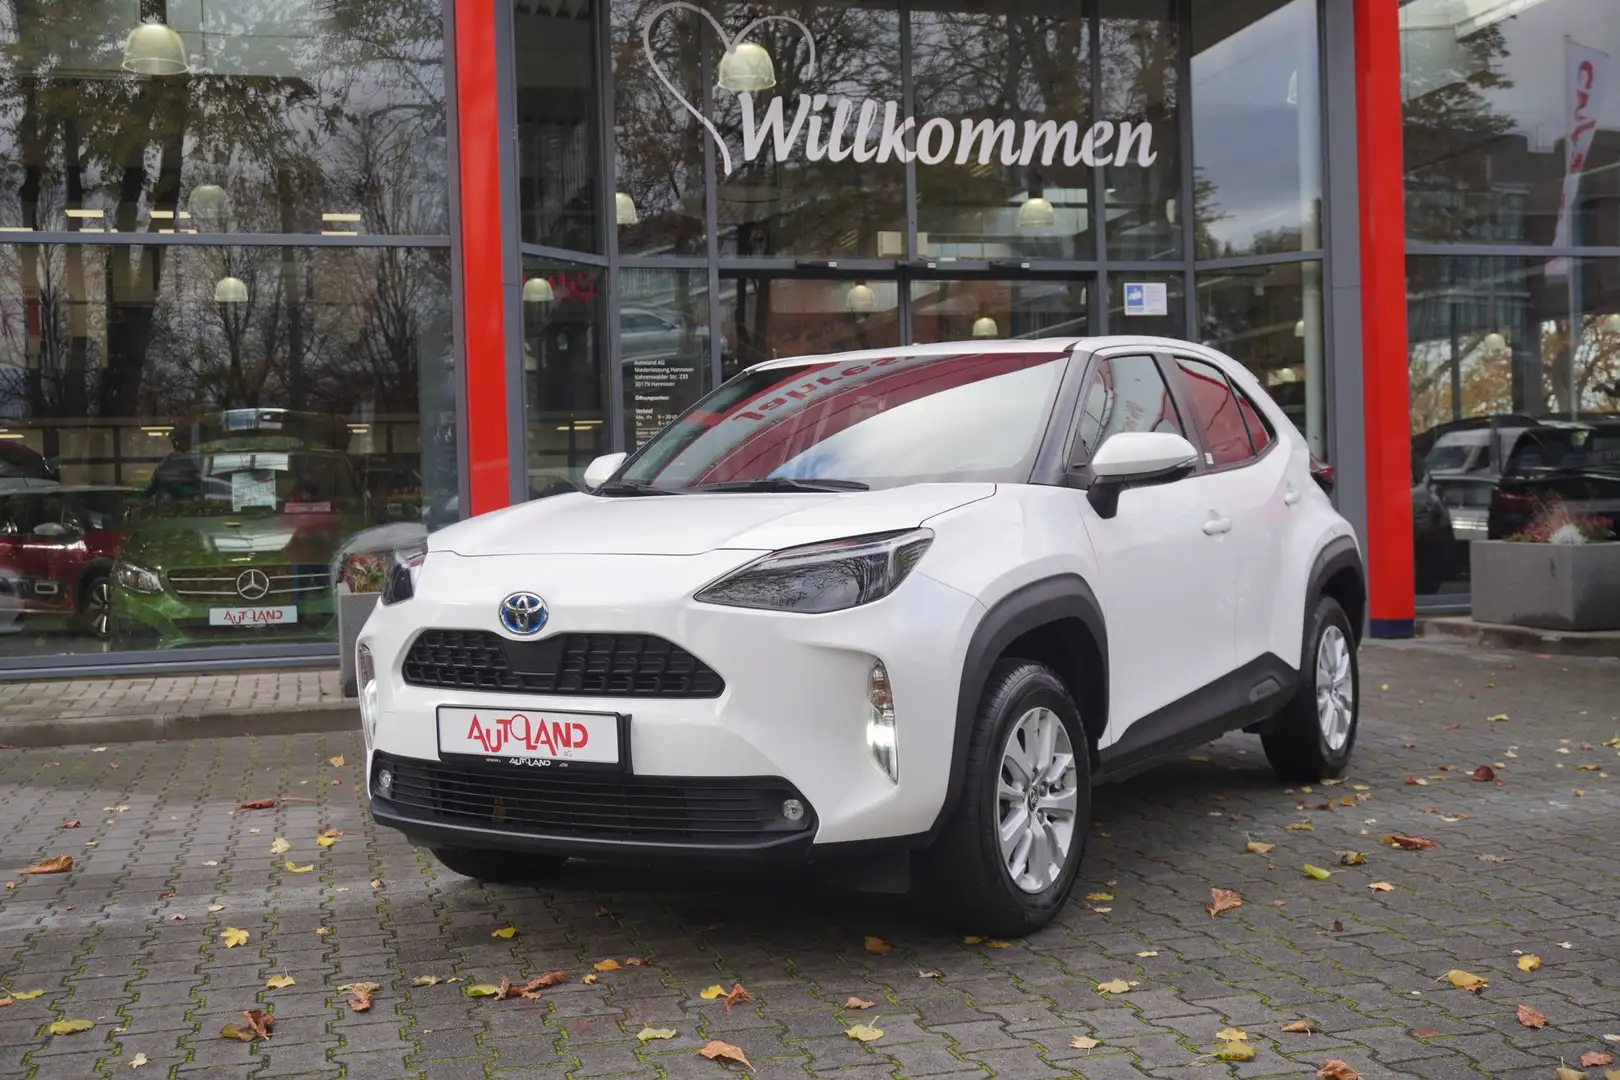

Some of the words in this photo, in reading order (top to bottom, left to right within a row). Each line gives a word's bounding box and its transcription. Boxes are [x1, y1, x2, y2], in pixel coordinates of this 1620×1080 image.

[739, 92, 1156, 168] Willkommen
[224, 609, 283, 624] AUTOLAND
[467, 713, 588, 756] AUTOLAND
[509, 756, 551, 767] AUTOLAND
